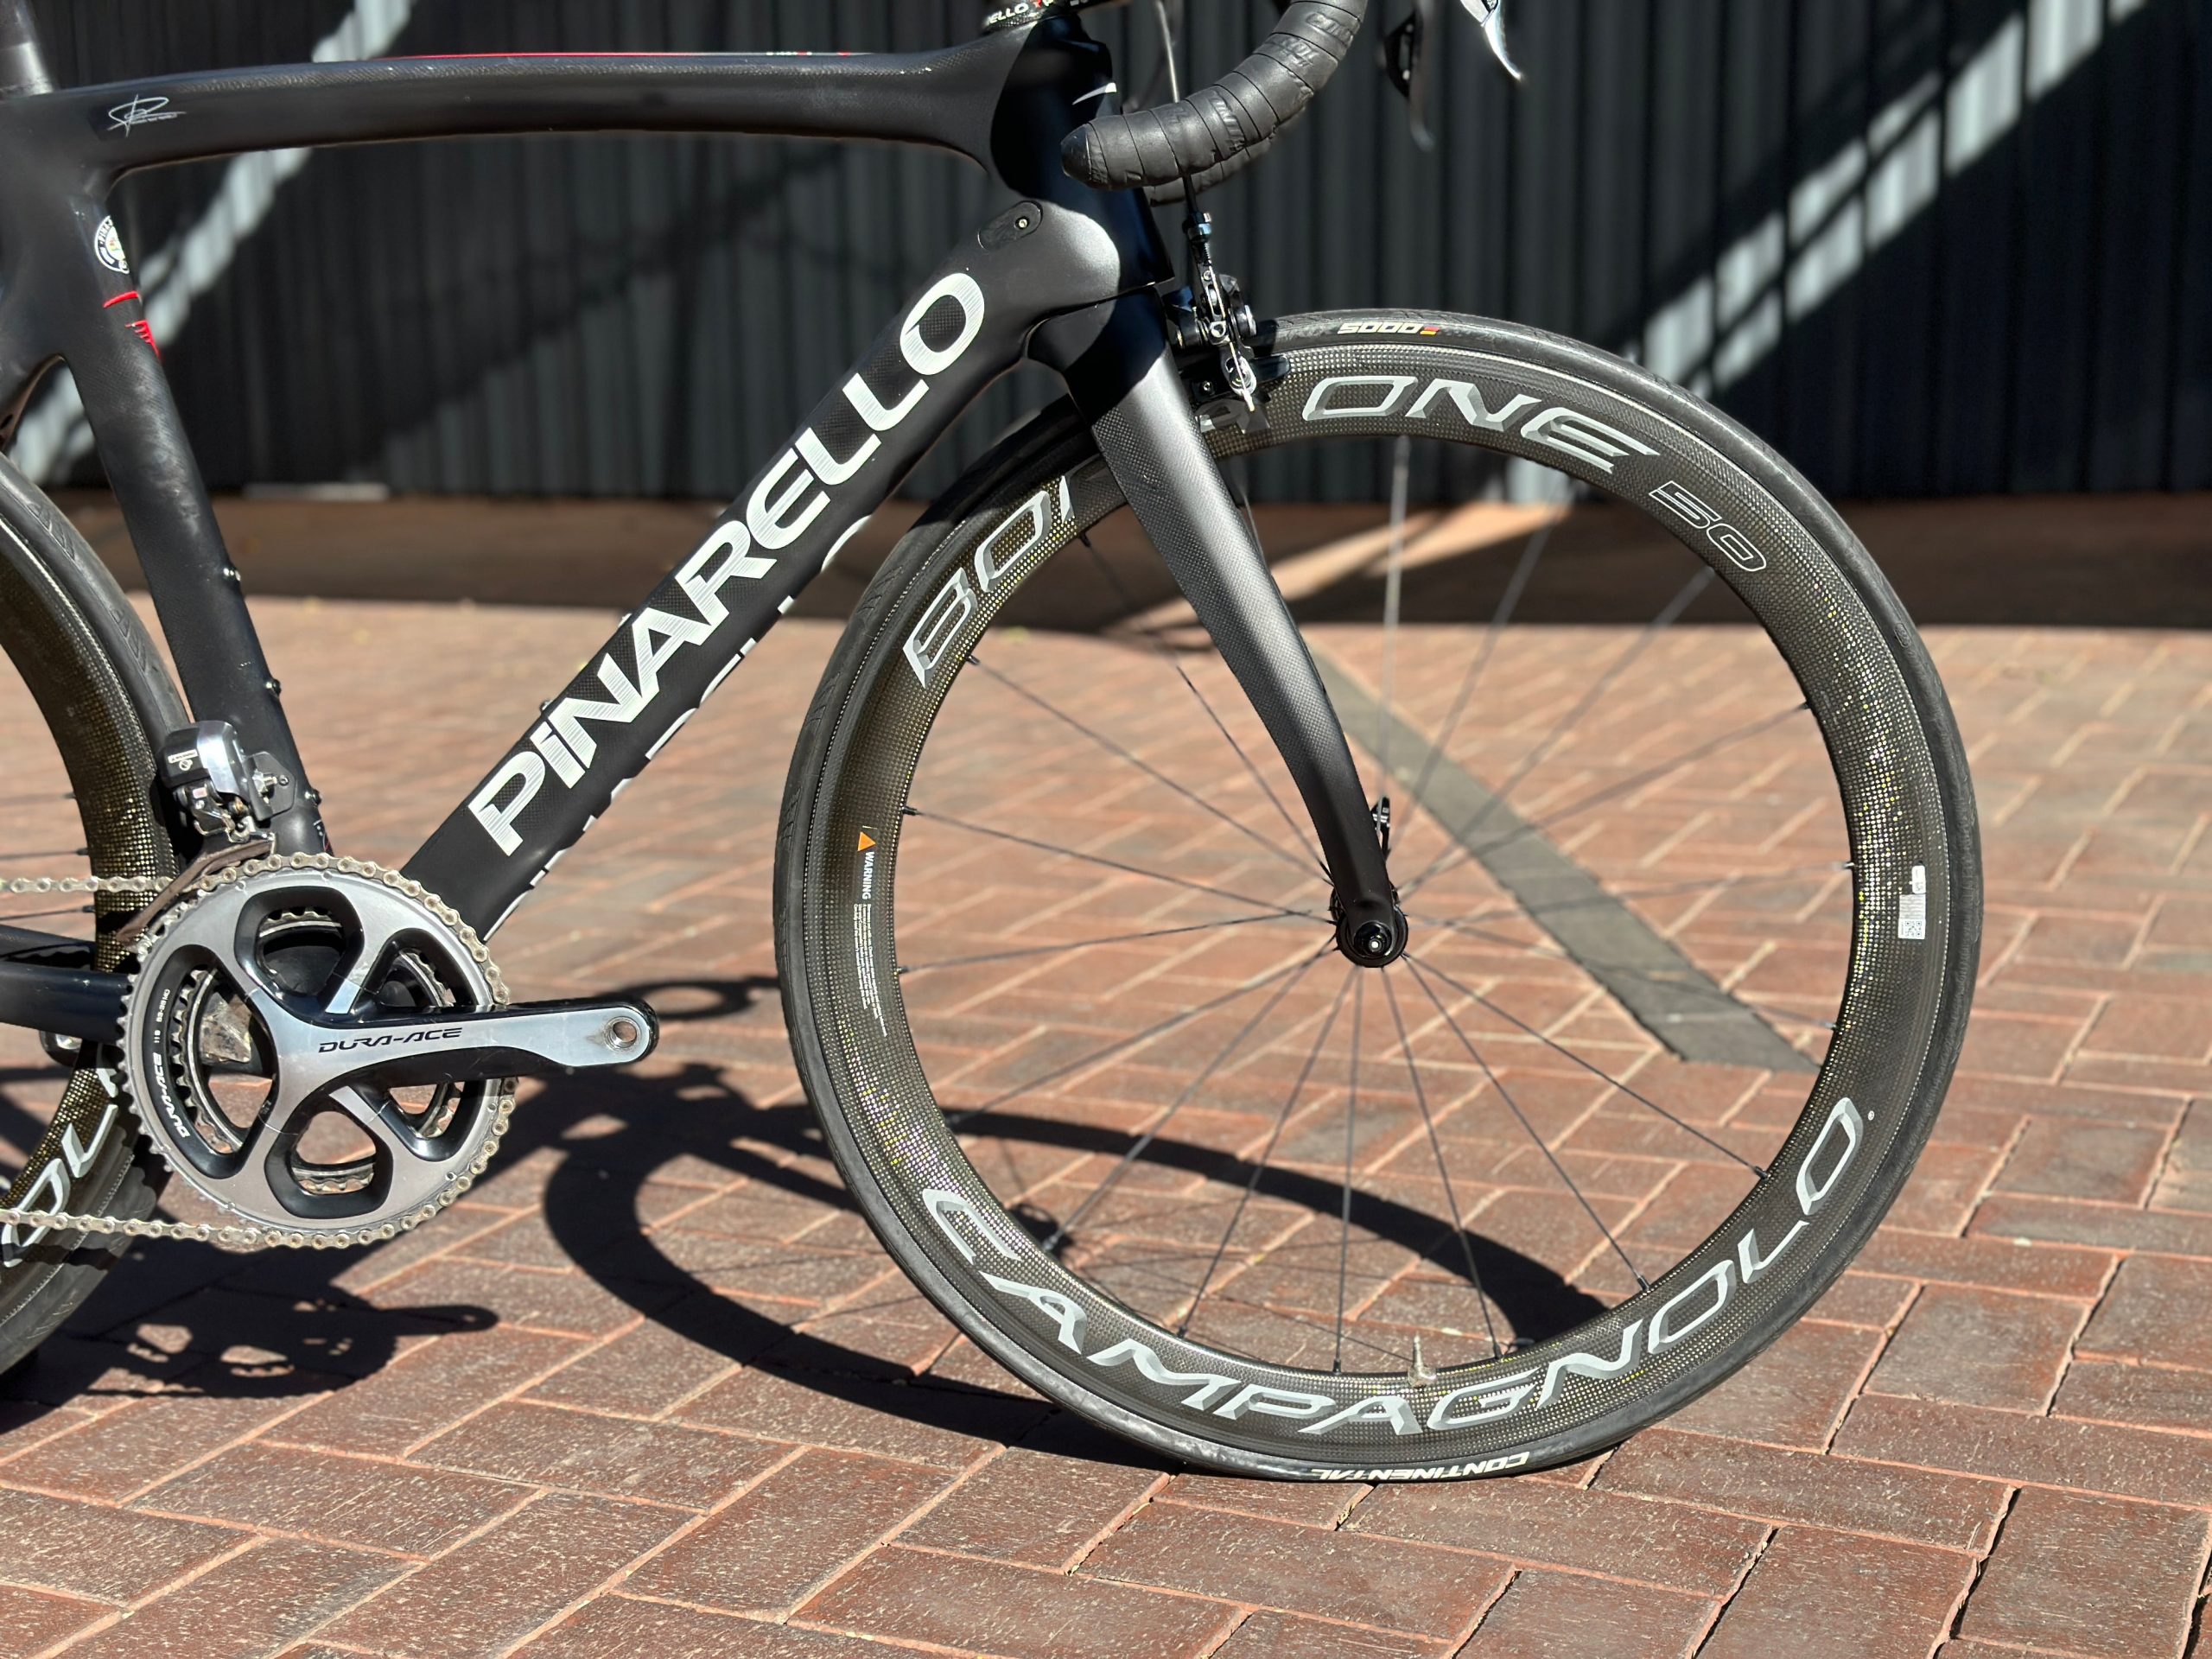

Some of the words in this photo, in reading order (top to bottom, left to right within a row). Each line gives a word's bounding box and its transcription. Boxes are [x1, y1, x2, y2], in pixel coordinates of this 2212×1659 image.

[1337, 322, 1424, 334] 5000
[1302, 375, 1661, 474] ONE
[1649, 480, 1767, 572] 50
[862, 851, 874, 899] WARNING
[319, 1027, 462, 1053] DURA-ACE
[152, 1052, 191, 1138] DURA-ACE
[923, 1096, 1863, 1436] CAMPAGNOLO
[1311, 1451, 1530, 1480] CONTINENTAL
